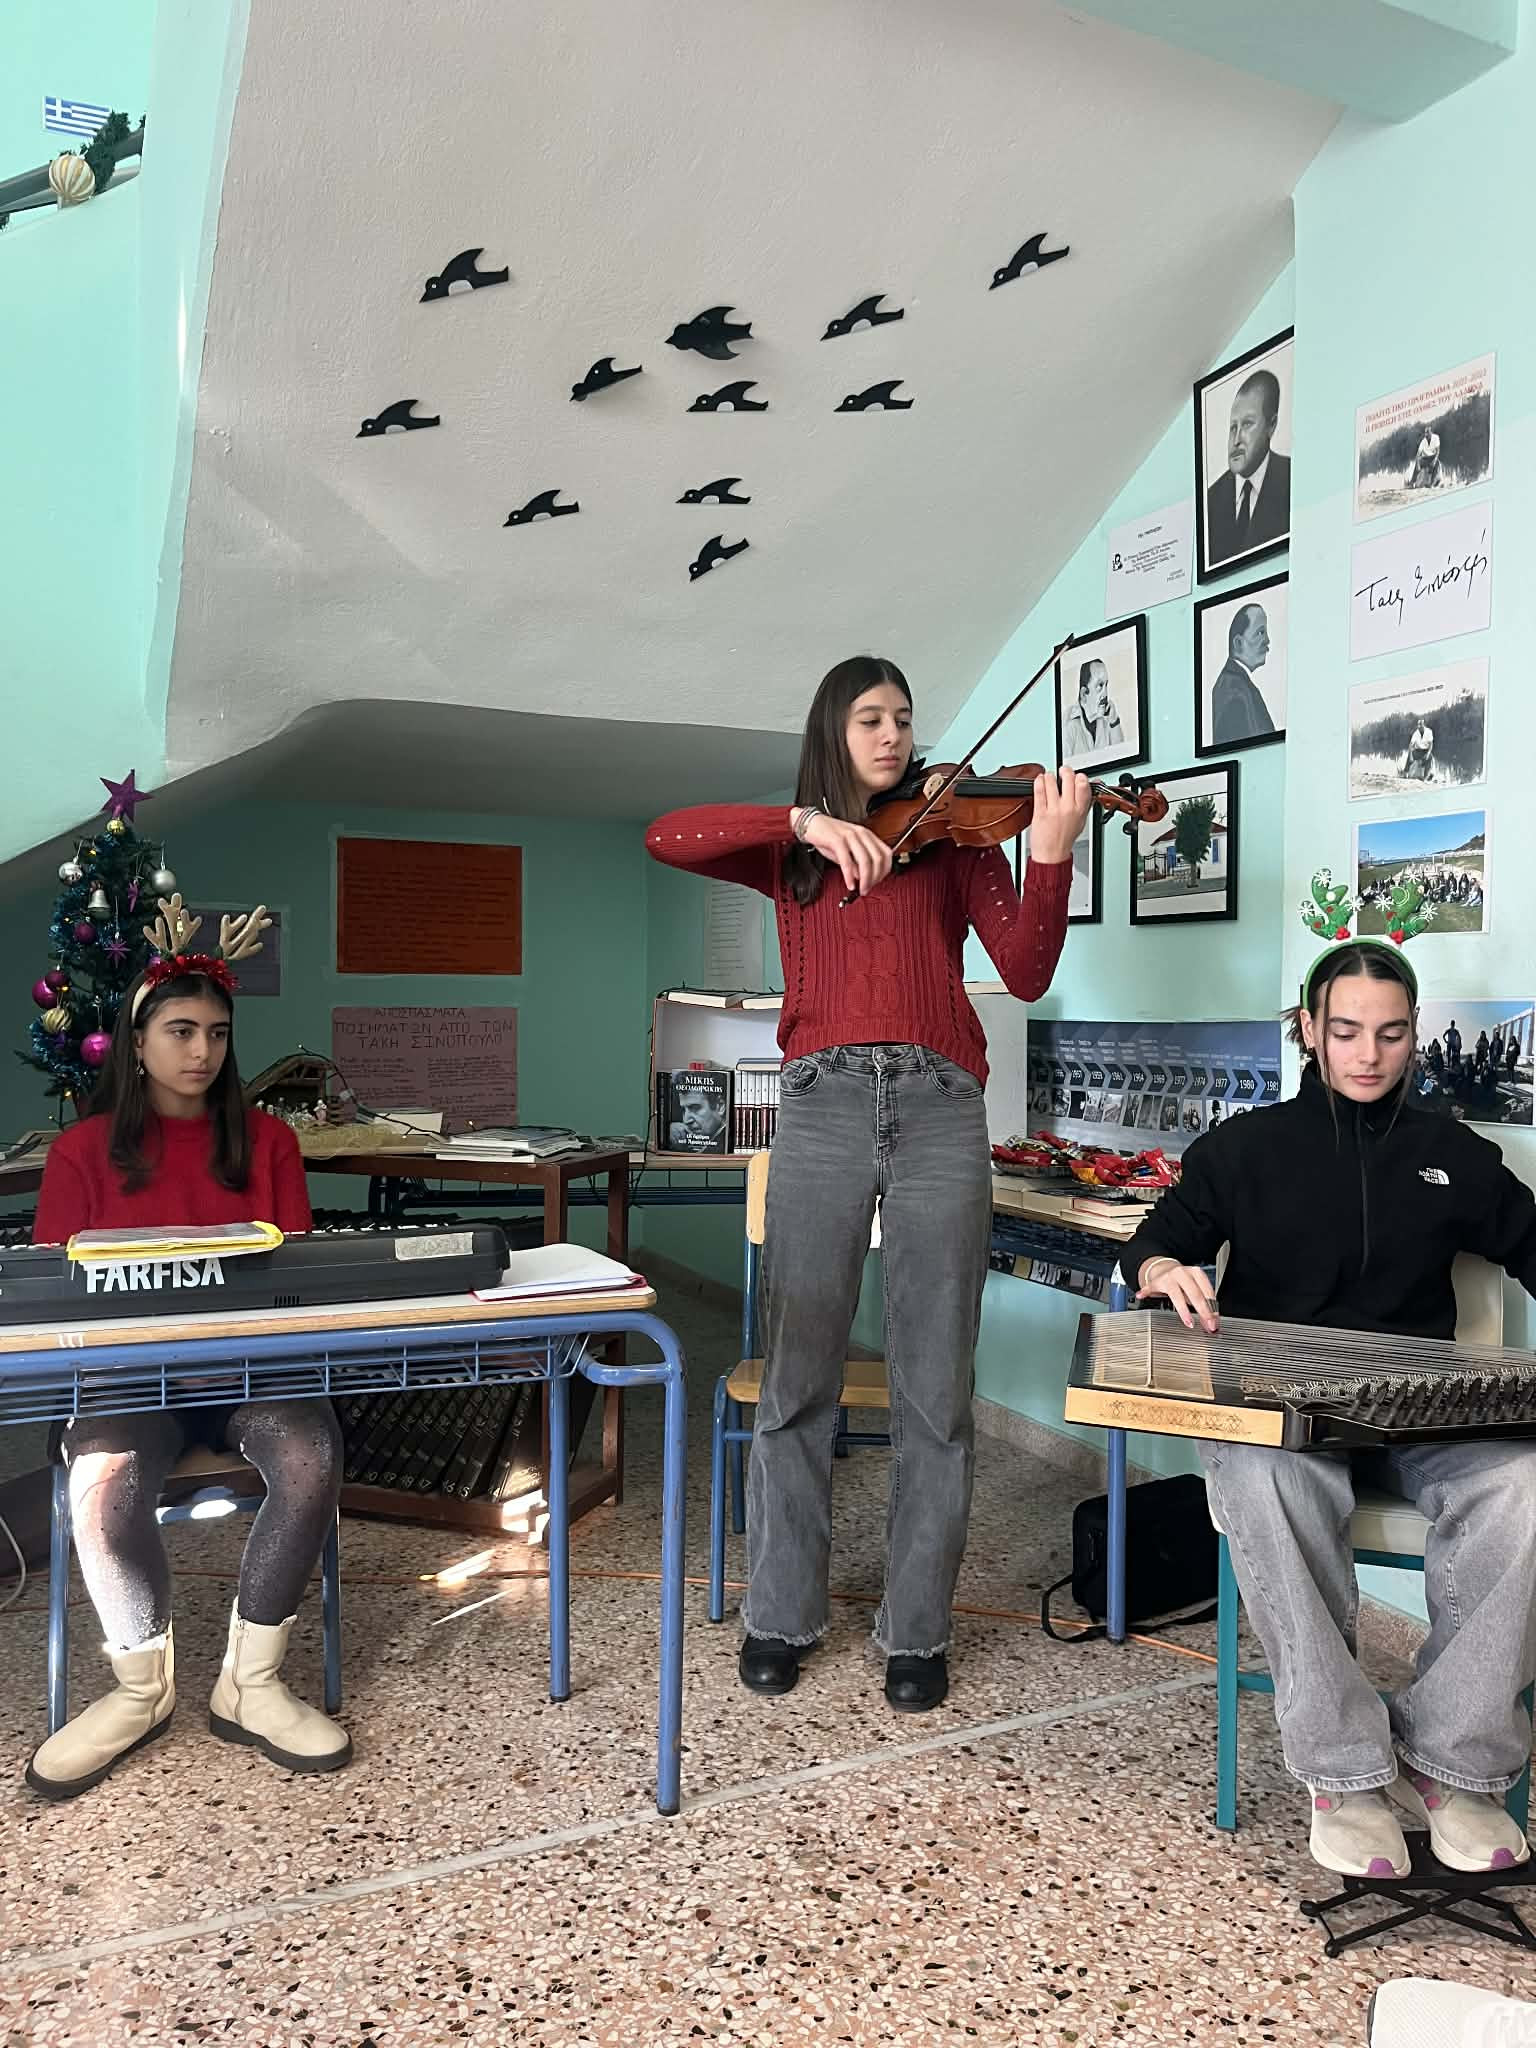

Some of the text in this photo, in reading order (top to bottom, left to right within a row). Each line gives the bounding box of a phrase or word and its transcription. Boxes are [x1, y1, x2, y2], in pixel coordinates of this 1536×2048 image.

[374, 1007, 466, 1018] ΑΠΟΣΠΑΣΜΑΤΑ
[334, 1021, 431, 1035] ΠΟΙΗΜΑΤΩΝ
[439, 1021, 471, 1034] ΑΠΟ
[358, 1033, 503, 1050] ΤΑΚΗ ΣΙΝΟΠΟΥΛΟ
[1215, 1078, 1228, 1088] 1977
[1239, 1079, 1255, 1090] 1980
[1266, 1081, 1279, 1092] 1981
[84, 1256, 225, 1294] FARFISA
